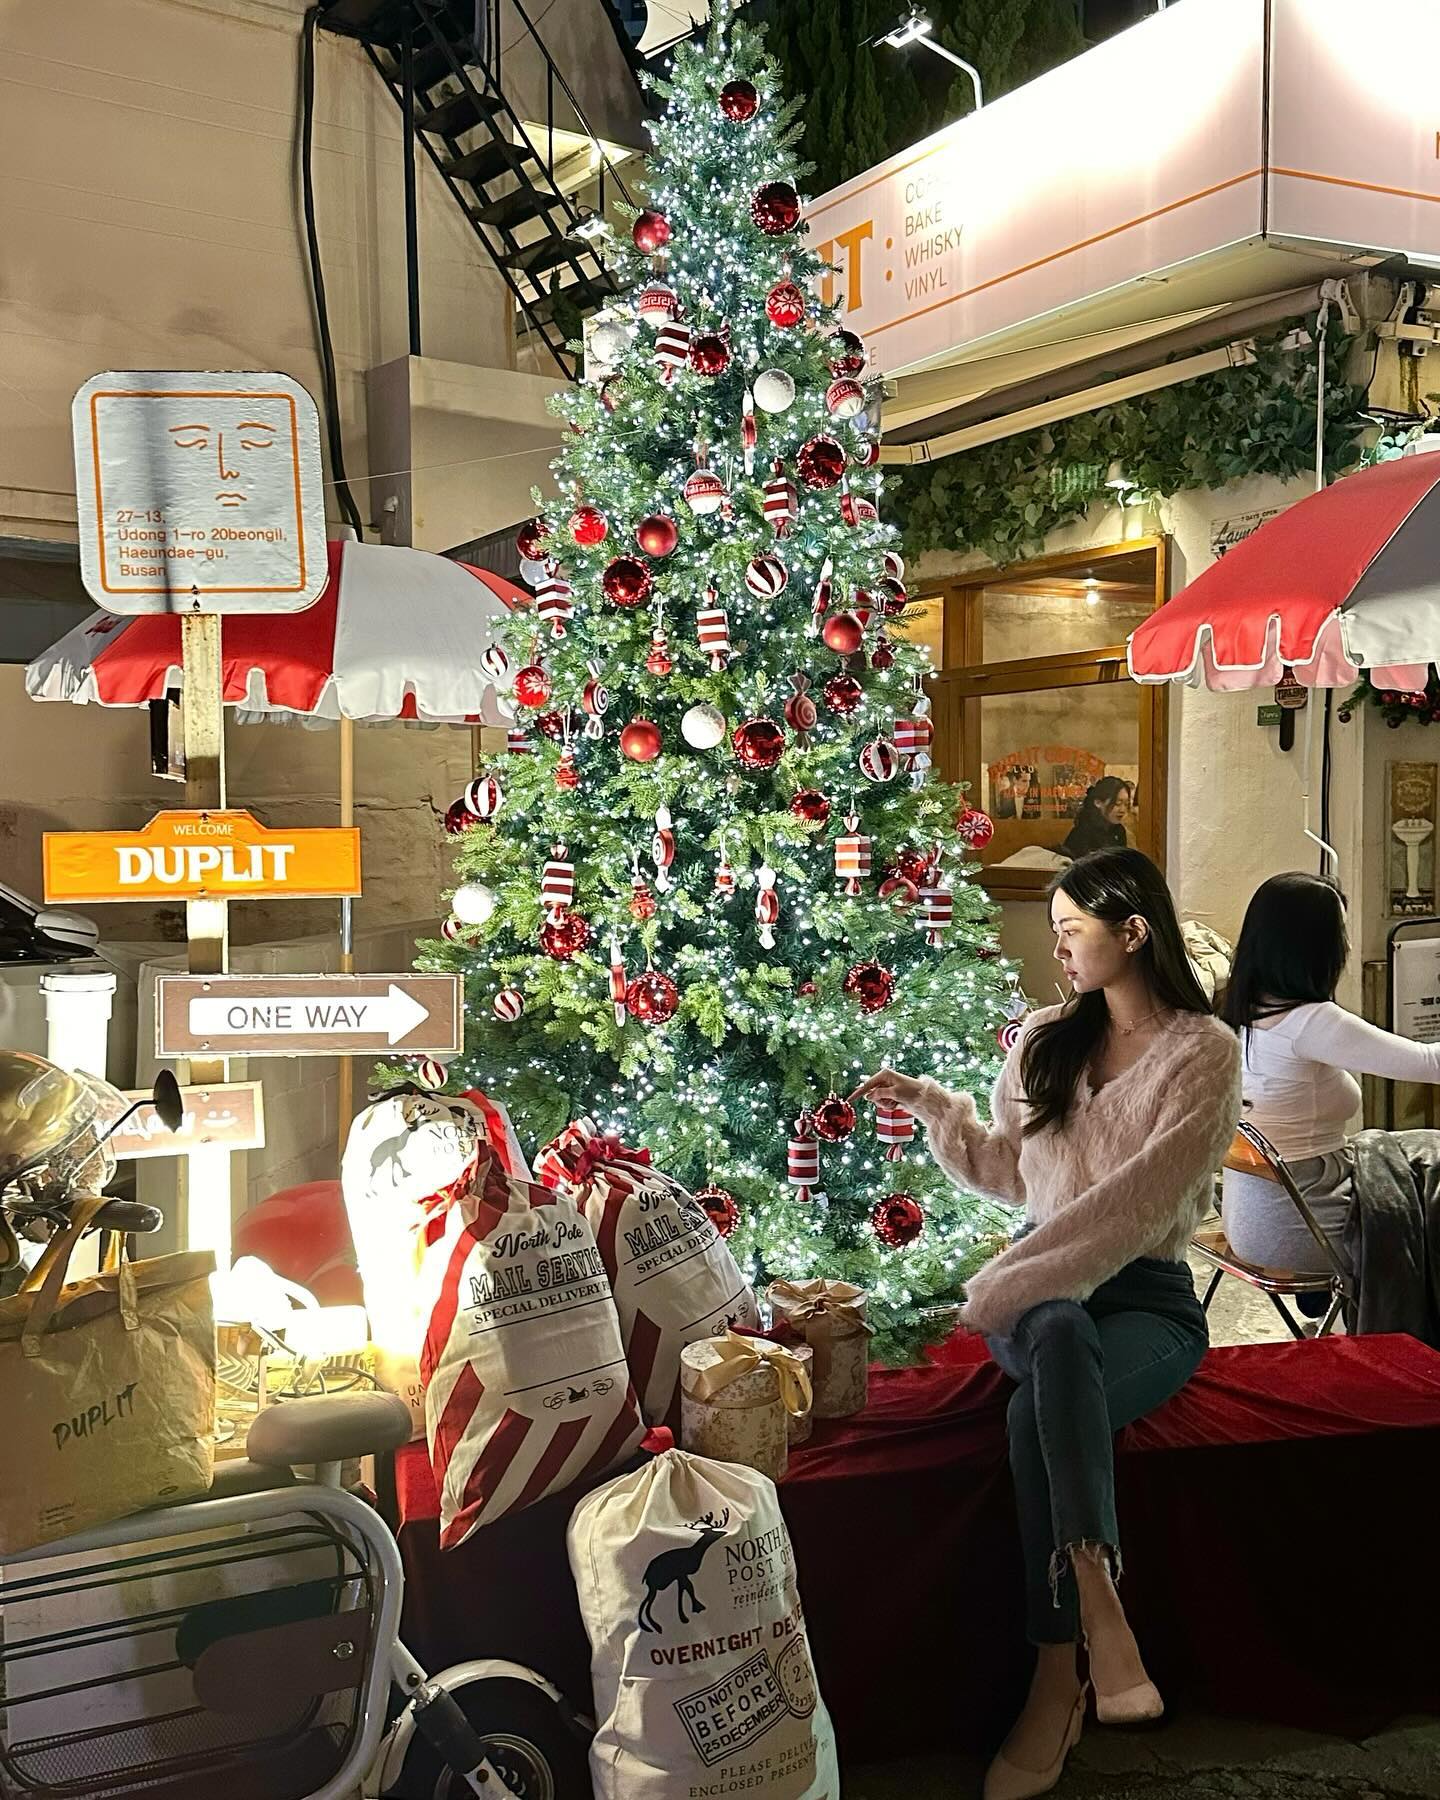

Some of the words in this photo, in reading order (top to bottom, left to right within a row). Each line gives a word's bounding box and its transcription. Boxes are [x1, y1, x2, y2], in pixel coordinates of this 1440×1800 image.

[905, 200, 943, 238] BAKE
[904, 224, 964, 270] WHISKY
[904, 267, 948, 301] VINYL
[1262, 509, 1278, 518] OPEN
[118, 528, 167, 542] Udong
[173, 528, 206, 541] 1-ro
[120, 564, 167, 577] Busan
[173, 823, 235, 837] WELCOME
[114, 844, 295, 885] DUPLIT
[1392, 903, 1433, 915] BATH
[227, 1005, 292, 1029] ONE
[305, 1004, 368, 1028] WAY
[492, 1229, 551, 1259] North
[552, 1221, 584, 1249] Pole
[623, 1214, 681, 1257] MAIL
[469, 1265, 533, 1305] MAIL
[536, 1246, 607, 1288] SERVIC
[636, 1244, 687, 1274] SPECIAL
[474, 1300, 538, 1325] SPECIAL
[539, 1282, 604, 1308] DELIVERY
[52, 1382, 138, 1450] DUPLIT
[724, 1526, 782, 1566] NORTH
[728, 1557, 774, 1585] POST
[650, 1626, 763, 1666] OVERNIGHT
[684, 1700, 706, 1719] DO
[708, 1681, 734, 1709] NOT
[734, 1656, 769, 1689] OPEN
[695, 1675, 777, 1739] BEFORE
[689, 1775, 764, 1798] ENCLOSED
[721, 1758, 772, 1779] PLEASE
